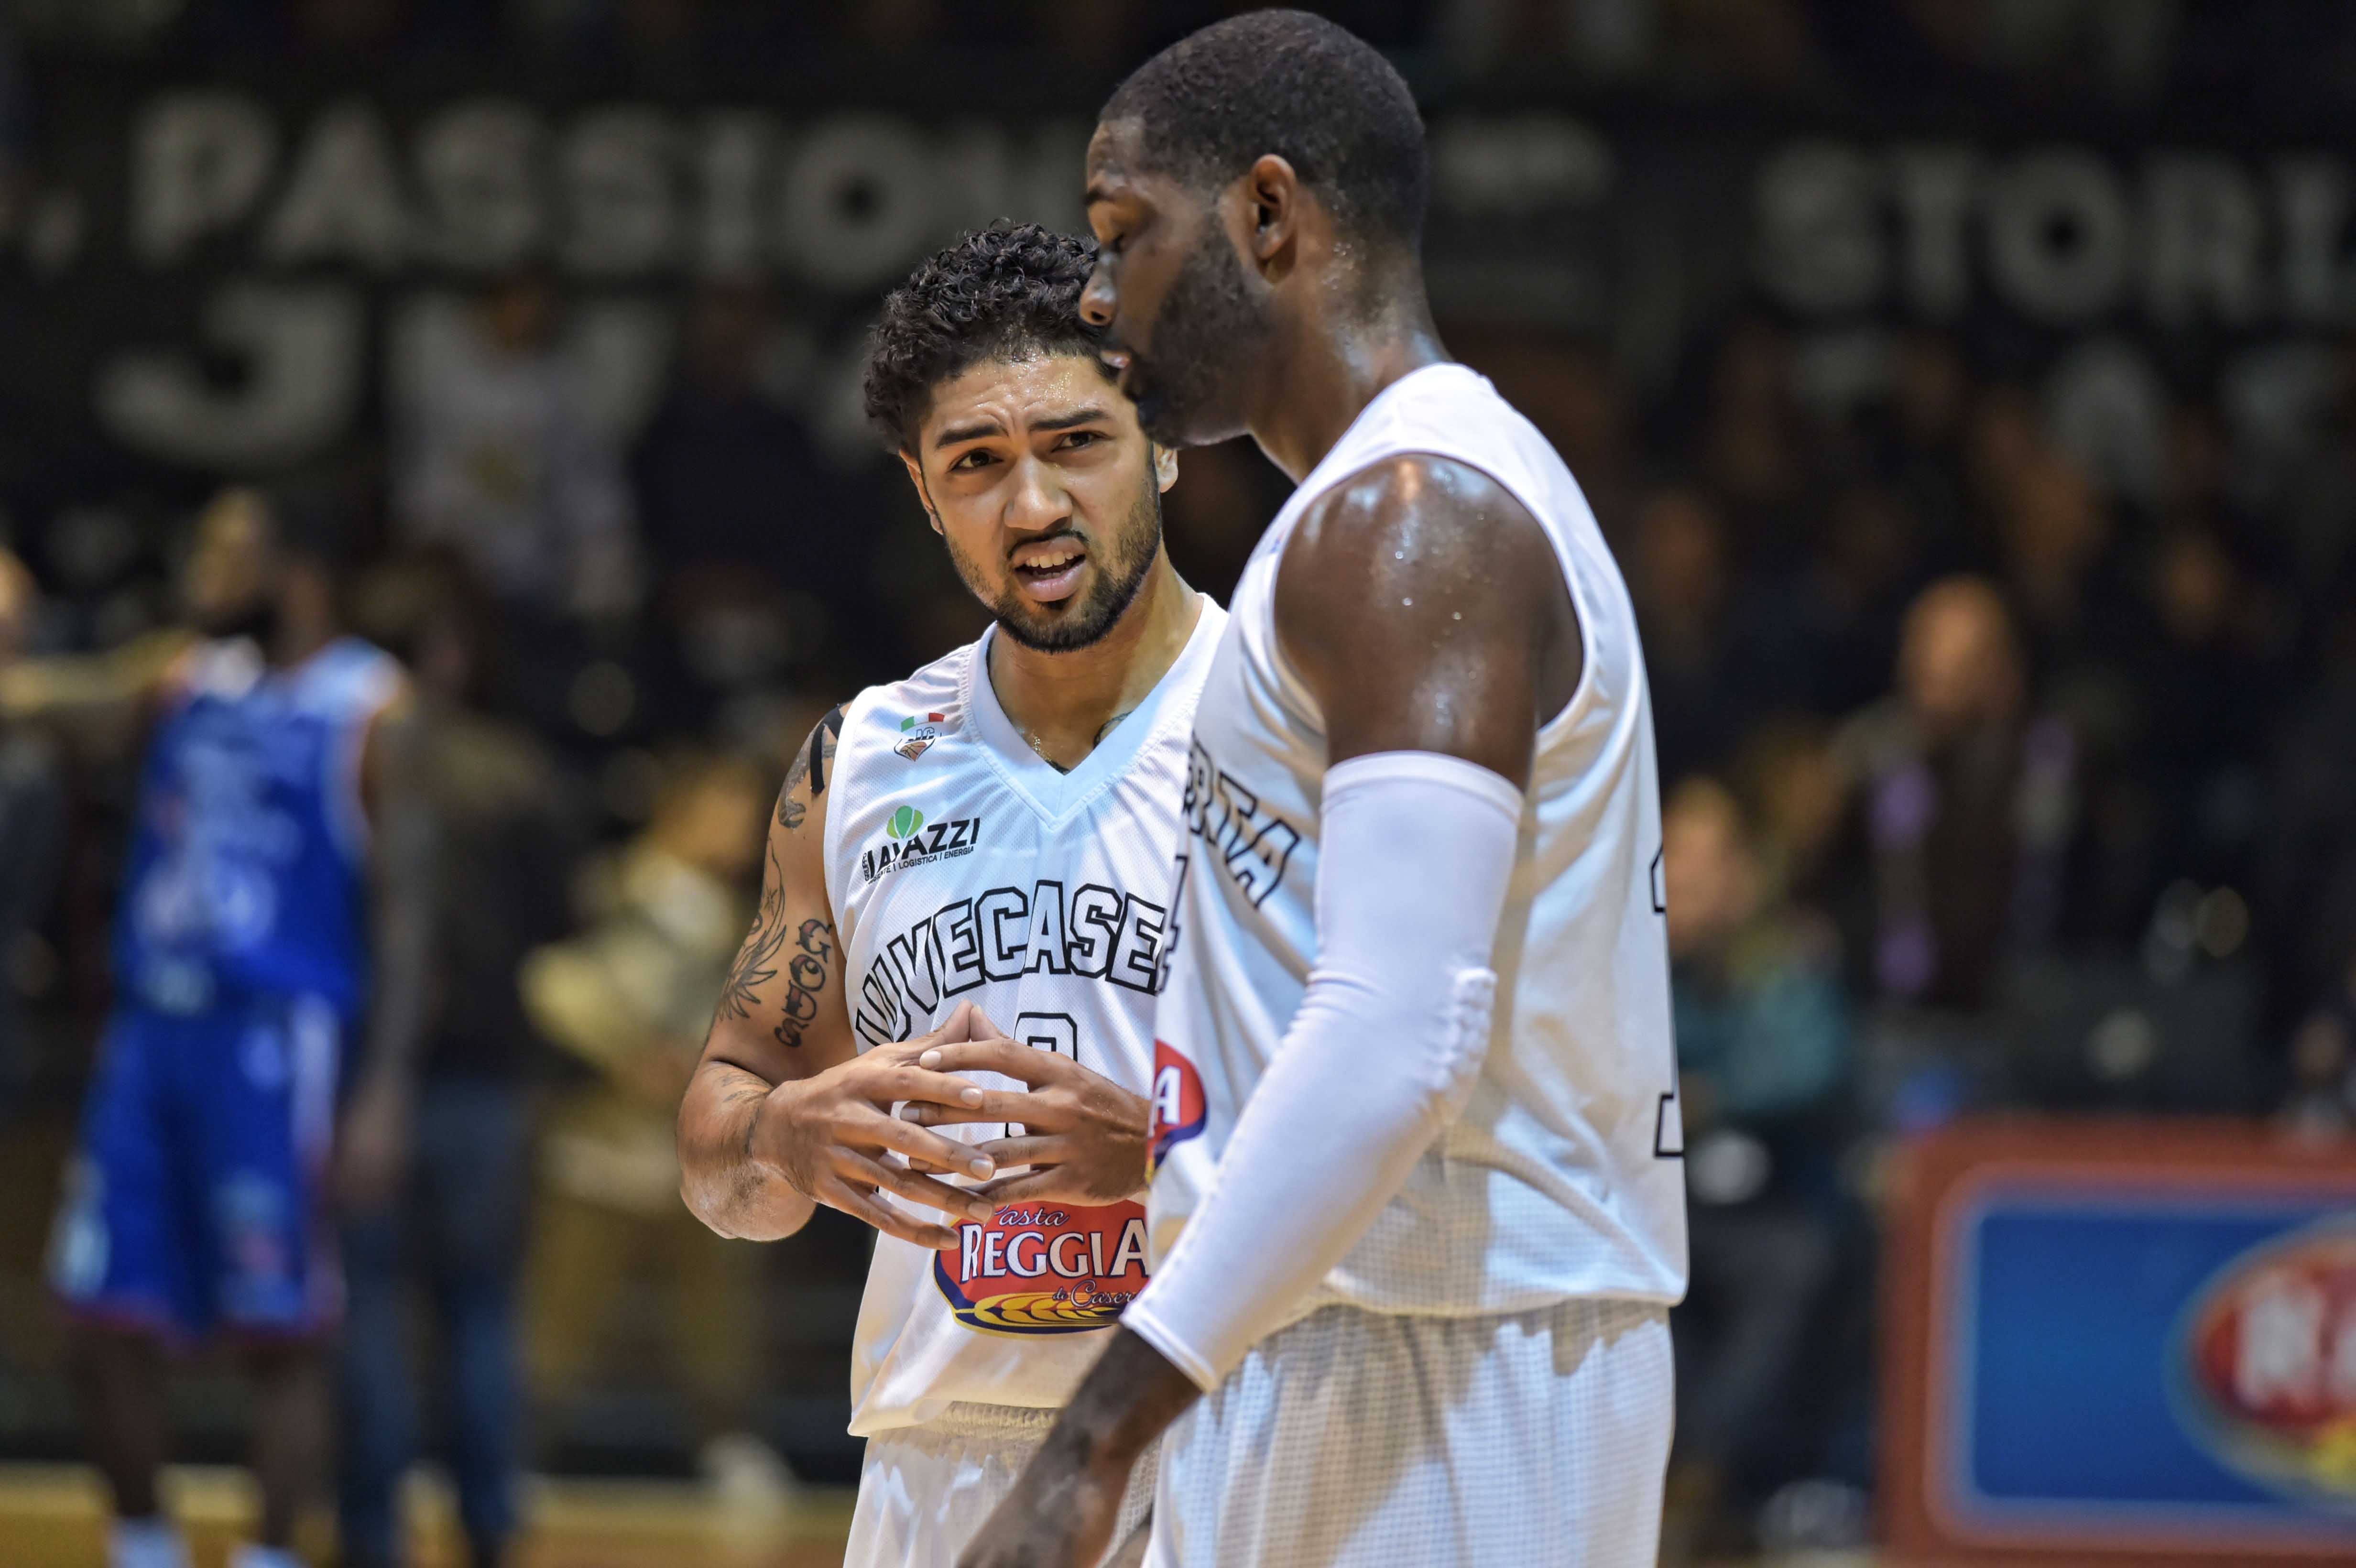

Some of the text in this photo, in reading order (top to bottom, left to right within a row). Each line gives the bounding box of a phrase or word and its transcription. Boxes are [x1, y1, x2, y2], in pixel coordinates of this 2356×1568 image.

[898, 854, 938, 870] LOGISTICA
[944, 845, 974, 860] ENERGIA
[994, 1204, 1071, 1227] asta
[960, 1218, 1149, 1284] REGGIA
